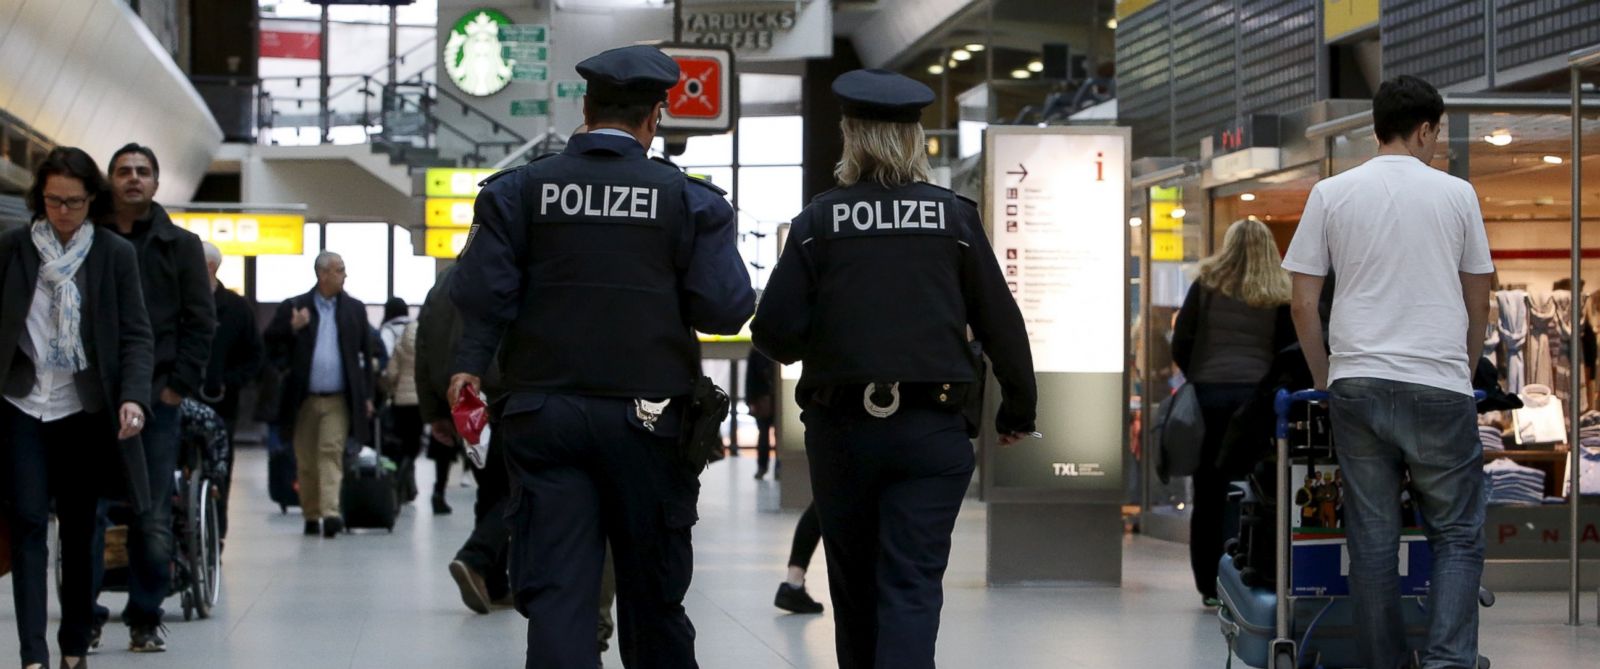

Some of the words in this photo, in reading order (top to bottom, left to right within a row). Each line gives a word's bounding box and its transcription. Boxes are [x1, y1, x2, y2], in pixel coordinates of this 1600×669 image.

[540, 183, 658, 219] POLIZEI
[832, 199, 946, 232] POLIZEI
[1052, 462, 1078, 476] TXL
